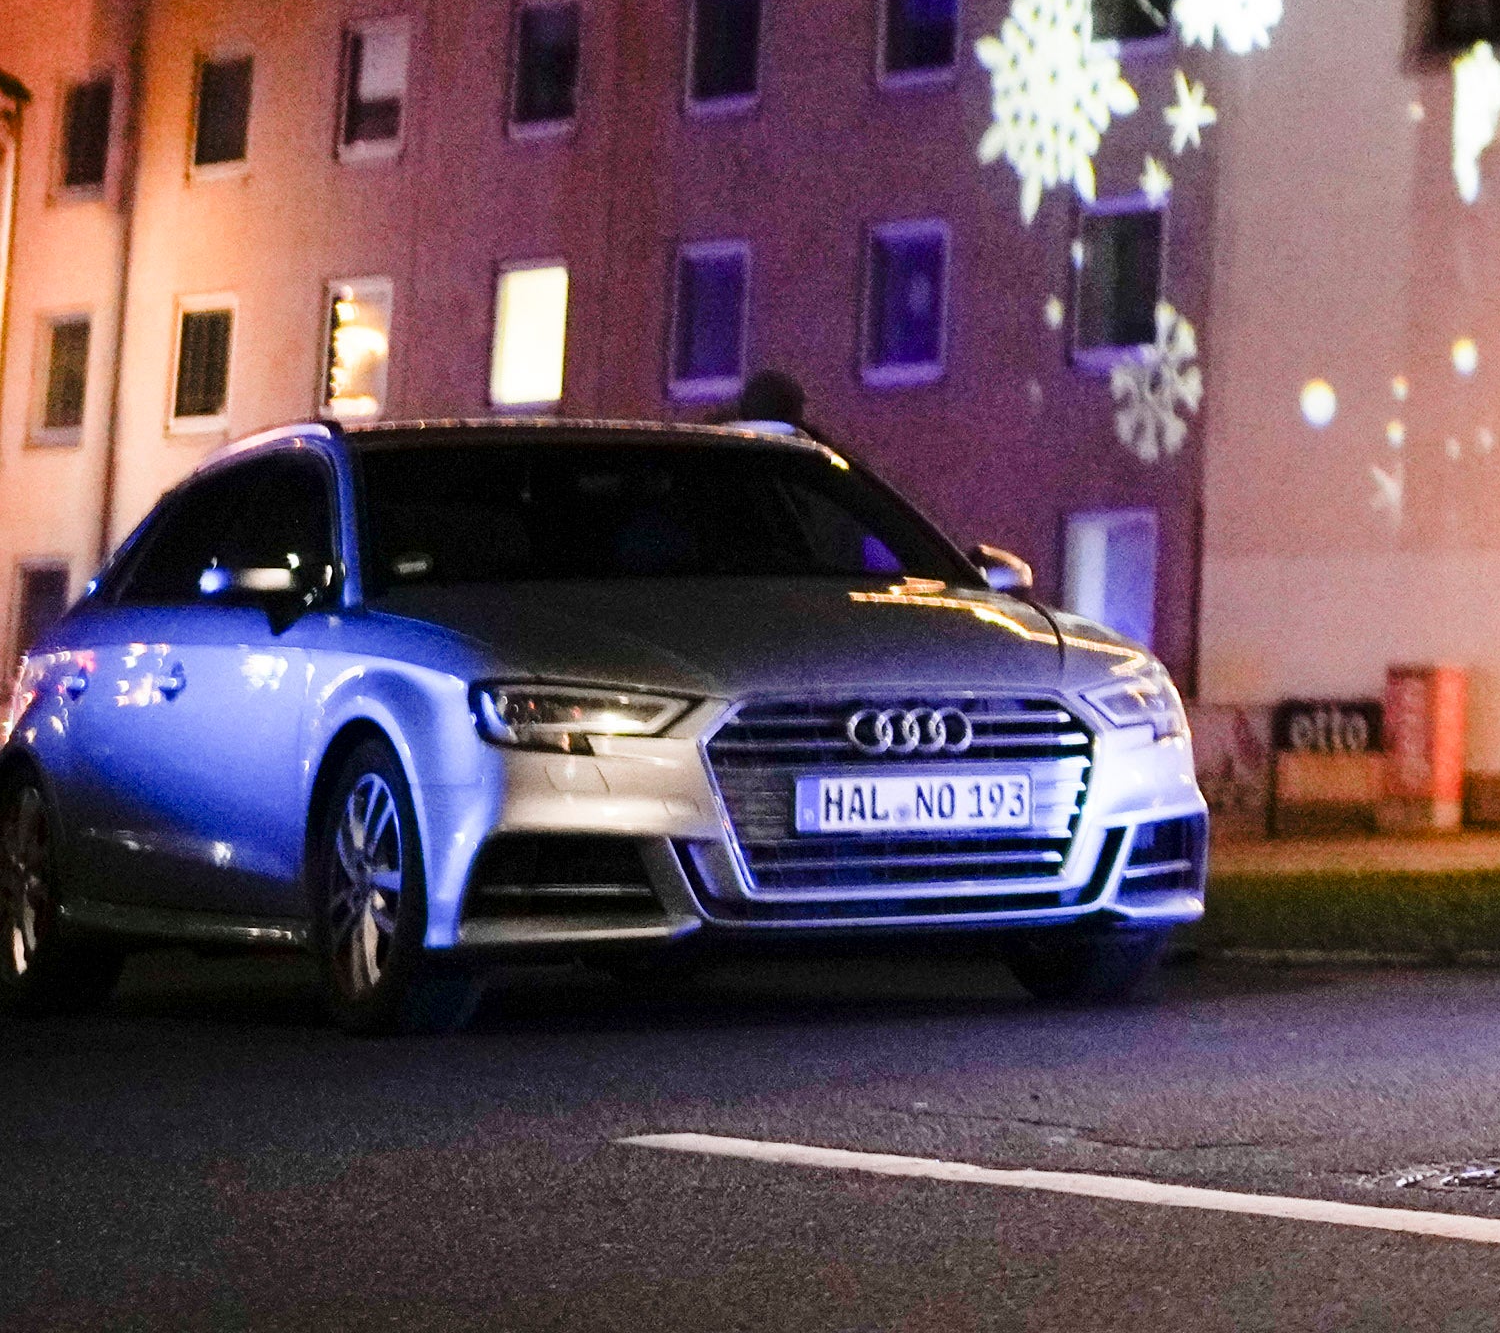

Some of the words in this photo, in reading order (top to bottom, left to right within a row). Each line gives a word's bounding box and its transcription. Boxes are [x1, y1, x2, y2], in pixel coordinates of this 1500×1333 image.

[825, 783, 889, 822] HAL
[915, 782, 956, 820] NO
[968, 781, 1025, 819] 193
